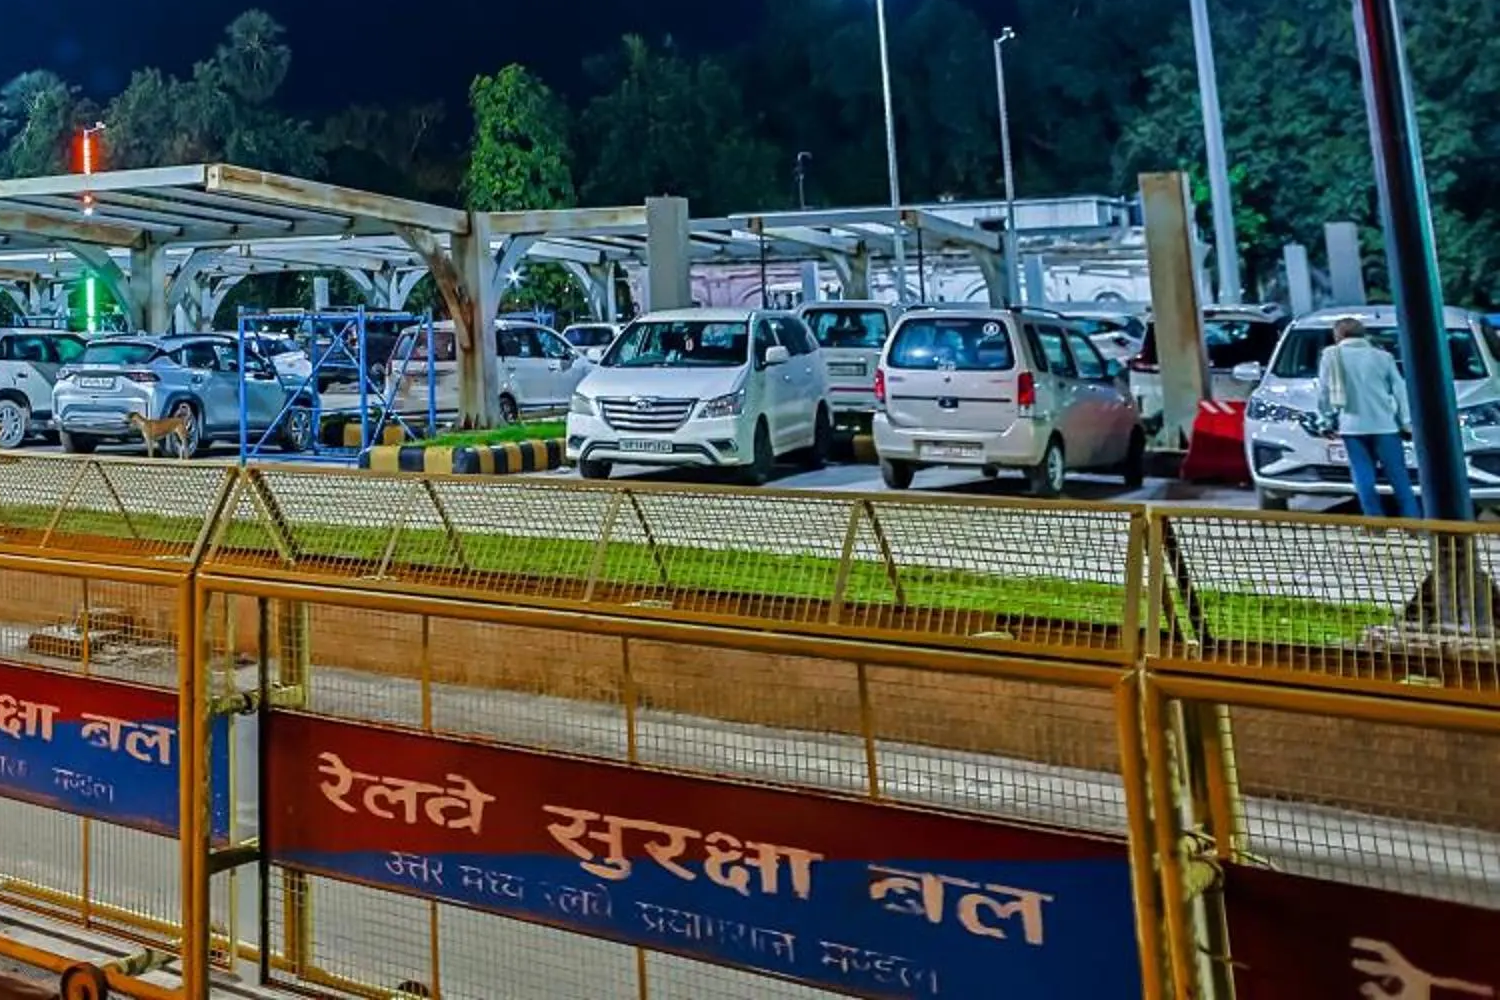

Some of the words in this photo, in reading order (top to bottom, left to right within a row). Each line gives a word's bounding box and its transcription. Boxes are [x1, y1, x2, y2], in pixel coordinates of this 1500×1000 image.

[80, 712, 176, 765] बल
[317, 751, 497, 836] रेलवे
[542, 804, 825, 900] सुरक्षा
[867, 854, 1055, 945] बल
[384, 851, 445, 885] उत्तर
